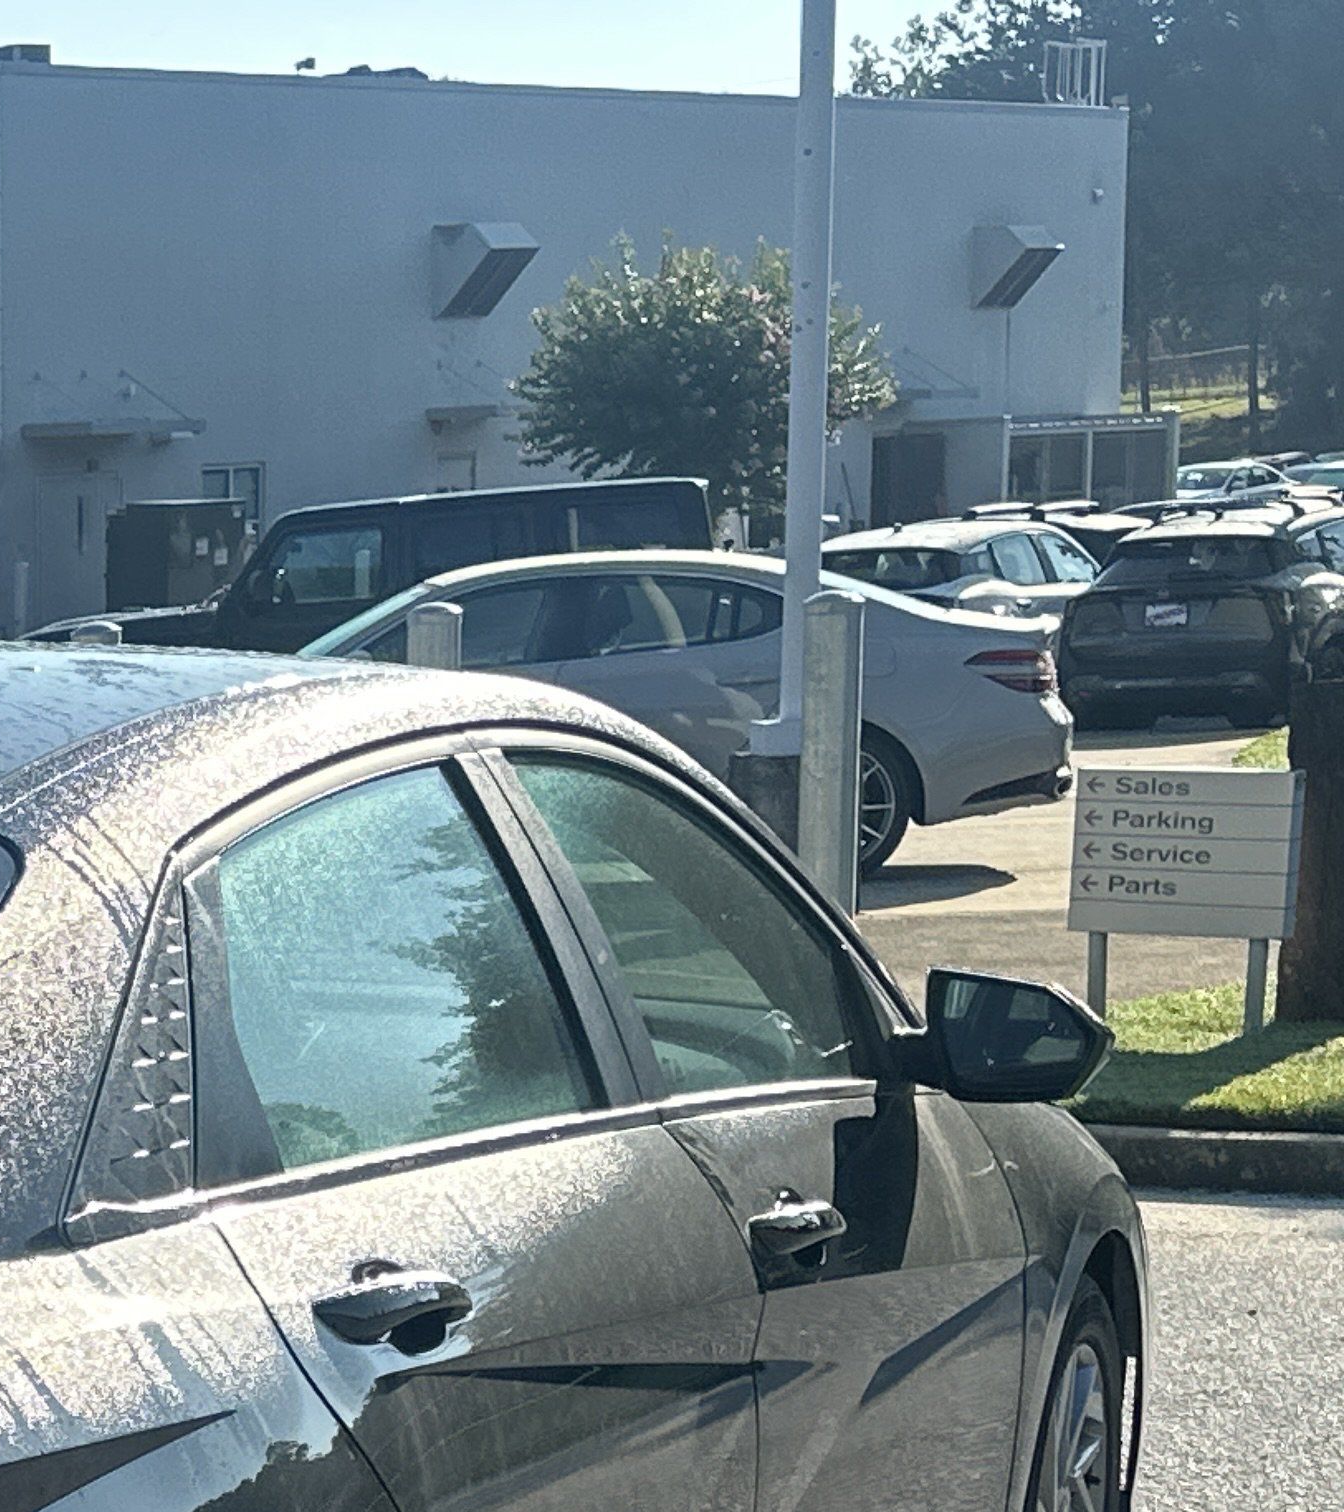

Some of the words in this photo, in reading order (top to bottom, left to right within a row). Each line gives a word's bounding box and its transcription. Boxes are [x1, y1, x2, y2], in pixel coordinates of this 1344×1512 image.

[1115, 776, 1191, 796] Sales
[1113, 809, 1214, 834] Parking
[1110, 842, 1211, 864] Service
[1108, 875, 1177, 896] Parts
